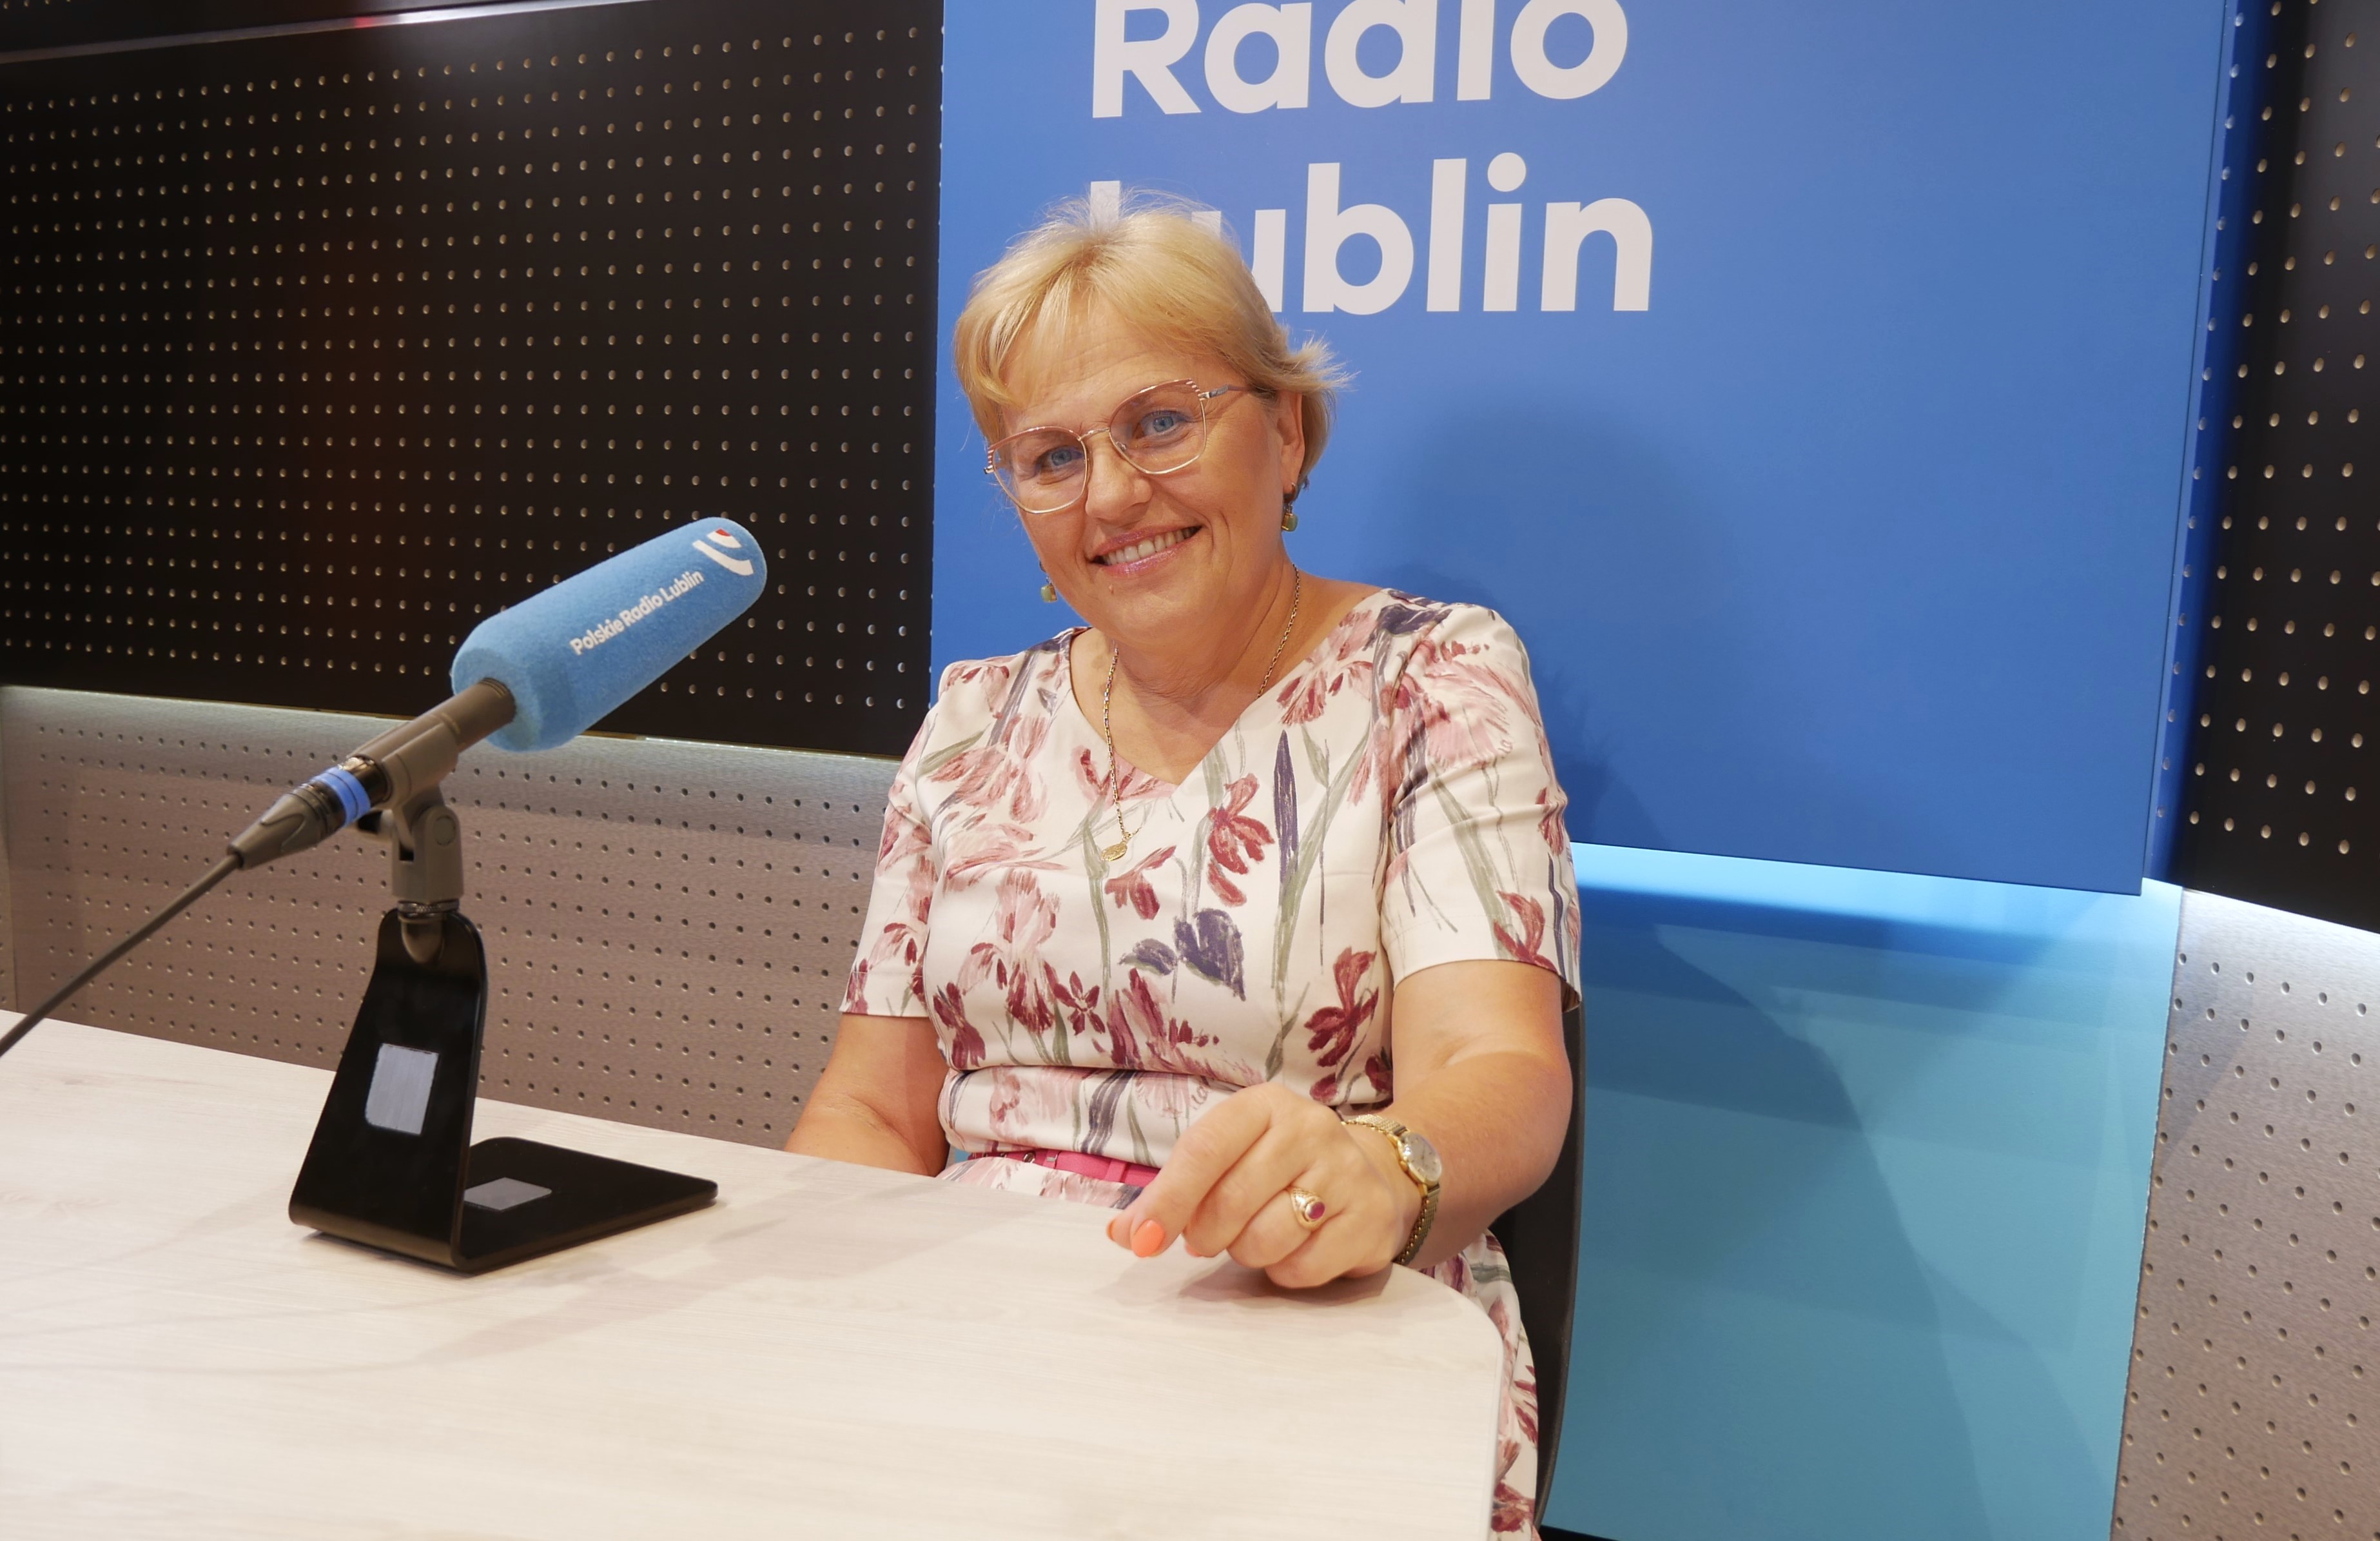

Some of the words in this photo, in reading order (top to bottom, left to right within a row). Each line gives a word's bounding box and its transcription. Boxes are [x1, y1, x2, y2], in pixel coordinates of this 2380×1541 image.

[1092, 0, 1628, 119] Radio
[1089, 152, 1653, 315] ublin
[570, 618, 625, 655] Polskie
[619, 595, 663, 627] Radio
[659, 571, 705, 602] Lublin
